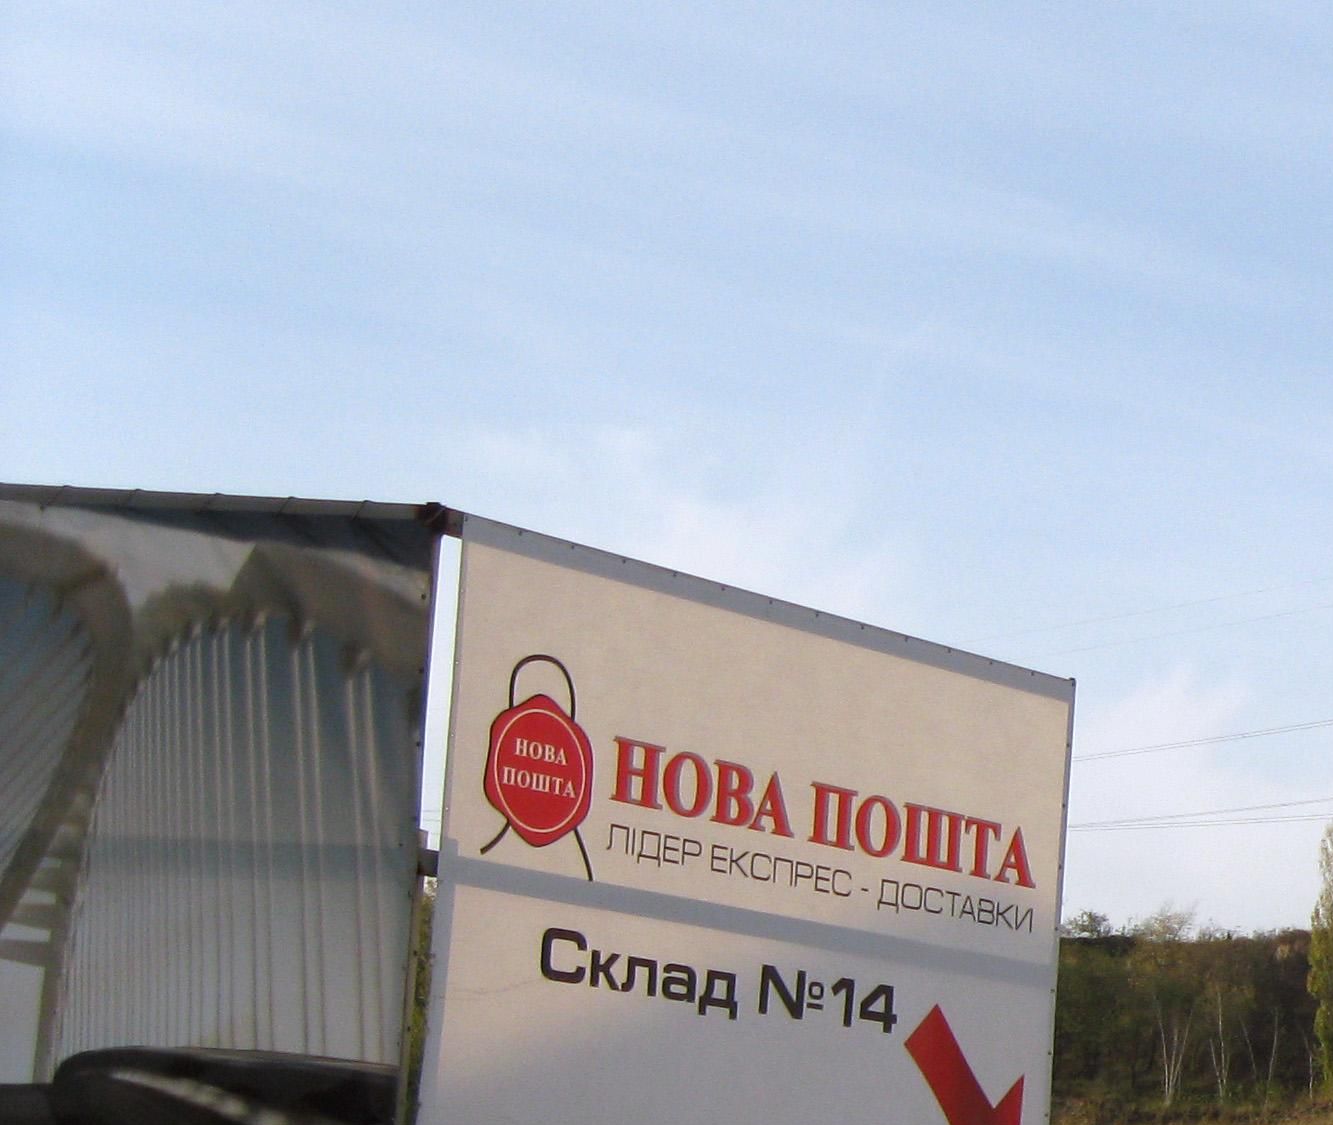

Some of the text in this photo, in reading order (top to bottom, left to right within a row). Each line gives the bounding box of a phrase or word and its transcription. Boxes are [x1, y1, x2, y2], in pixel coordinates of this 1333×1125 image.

[502, 766, 576, 798] ПОШТА
[515, 738, 568, 766] НОВА
[609, 735, 1037, 889] НОВА ПОШТА
[606, 823, 703, 867] ЛІДЕР
[710, 844, 852, 898] ЕКСПРЕС
[876, 879, 1035, 934] ДОСТАВКИ
[540, 927, 898, 1034] Склад №14
